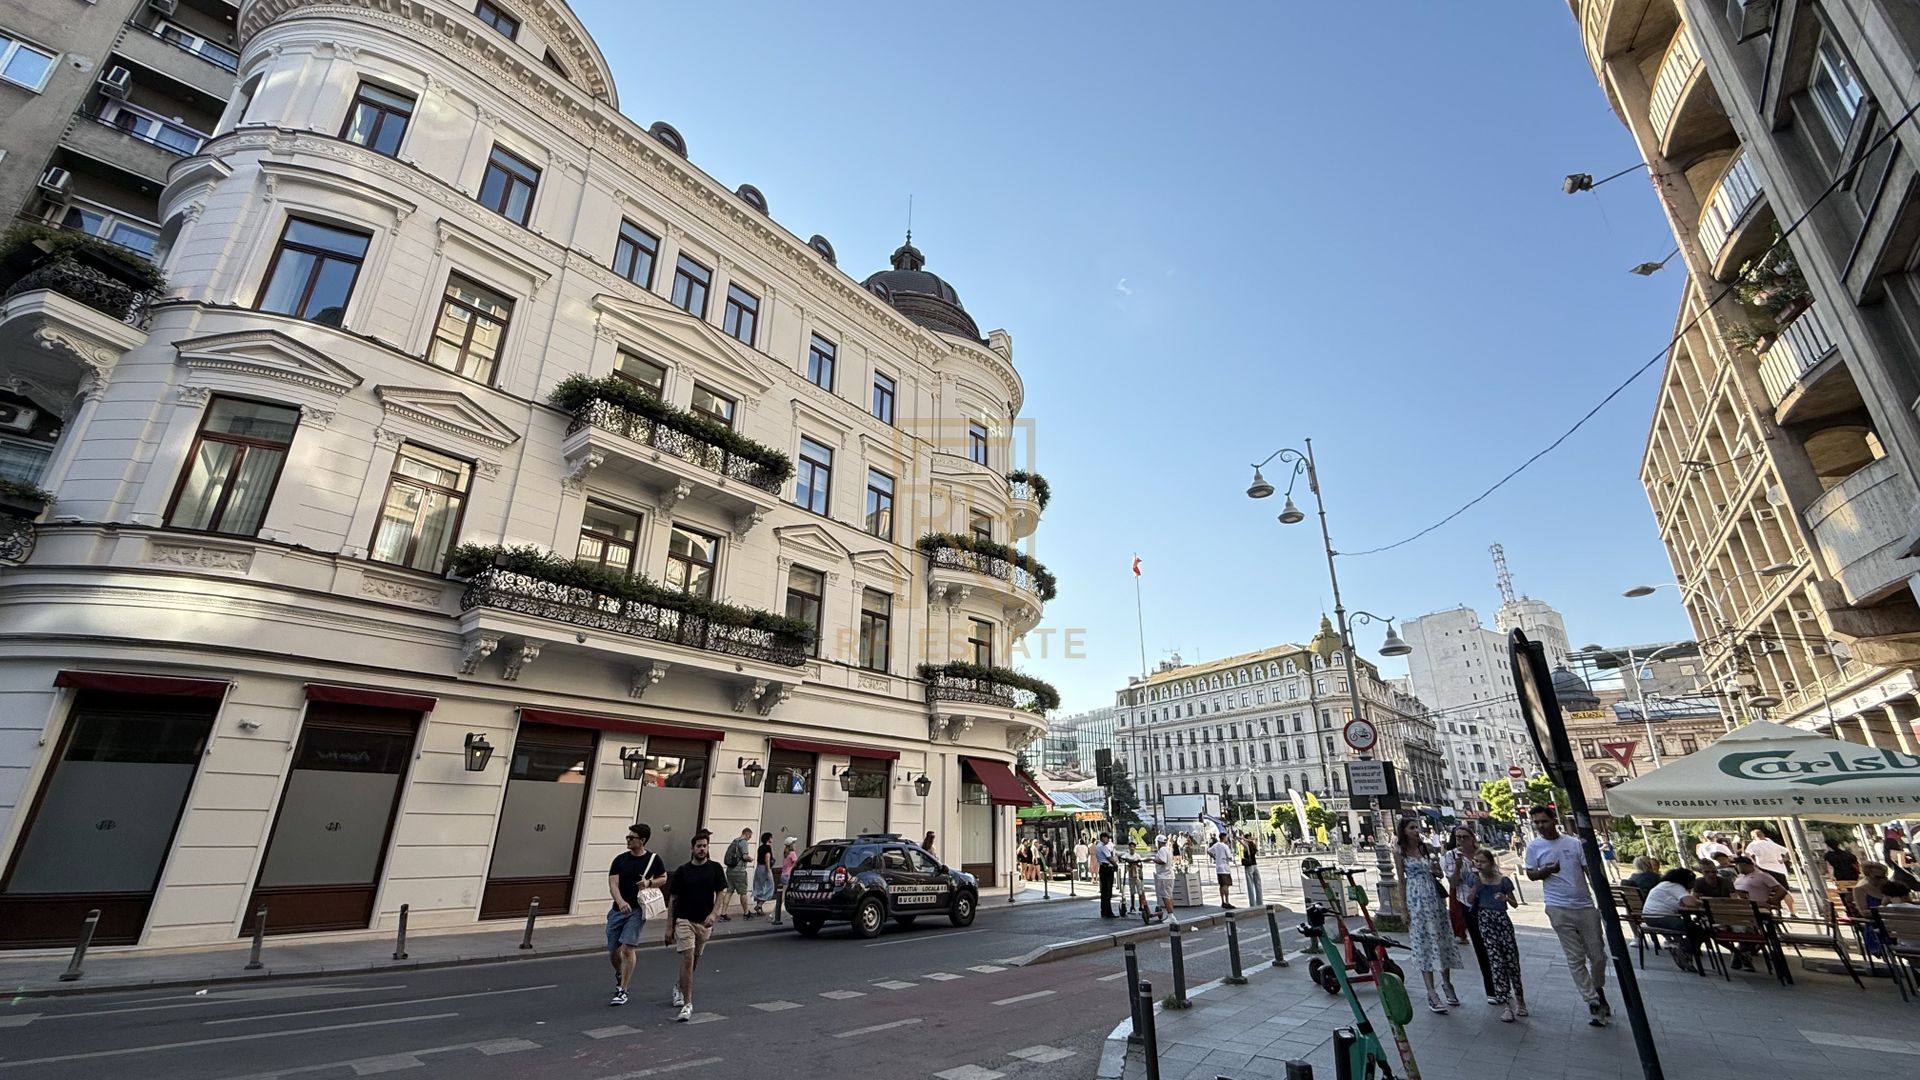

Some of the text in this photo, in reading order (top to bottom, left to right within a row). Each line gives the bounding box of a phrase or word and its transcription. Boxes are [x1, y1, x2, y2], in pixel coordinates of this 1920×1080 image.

[1656, 799, 1718, 807] PROBABLY
[1724, 798, 1748, 806] THE
[1752, 798, 1784, 806] BEST
[1814, 797, 1848, 805] BEER
[1855, 796, 1871, 804] IN
[1876, 795, 1905, 804] THE
